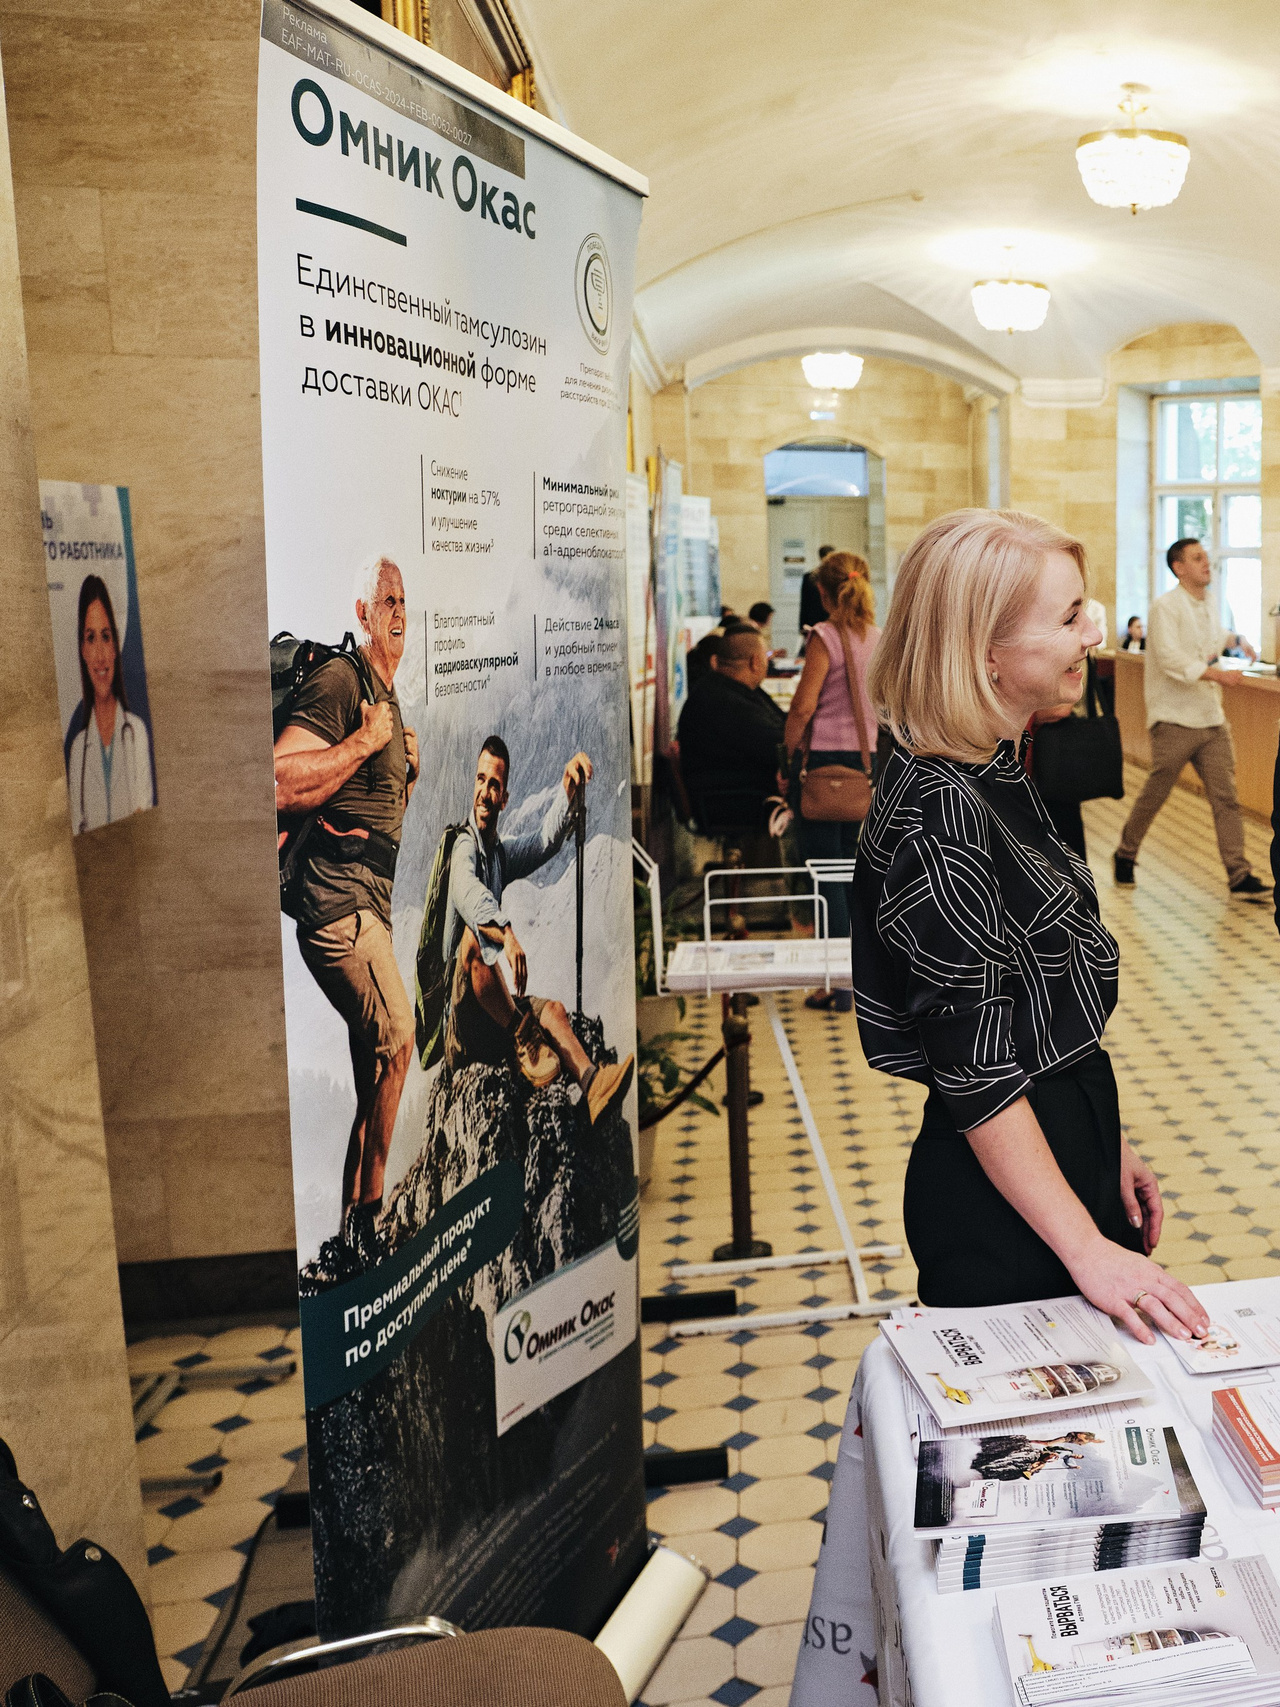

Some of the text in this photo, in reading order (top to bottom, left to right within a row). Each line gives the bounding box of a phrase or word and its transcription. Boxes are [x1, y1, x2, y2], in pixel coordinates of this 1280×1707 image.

[283, 6, 327, 45] Реклама
[291, 78, 536, 239] Омник Окас
[296, 252, 547, 356] Единственный тамсулозин
[300, 314, 536, 393] в инновационной форме
[301, 366, 412, 407] доставки
[430, 459, 469, 481] Снижение
[431, 486, 500, 507] ноктурии на 57%
[543, 477, 608, 496] Минимальный
[543, 499, 606, 517] ретроградной
[431, 516, 478, 531] и улучшение
[543, 524, 572, 538] среди
[60, 541, 123, 560] РАБОТНИКА
[431, 540, 462, 553] качества
[434, 612, 495, 629] Благоприятный
[545, 617, 619, 634] Действие 24 часа
[434, 637, 466, 654] профиль
[545, 645, 551, 655] и
[554, 640, 594, 658] удобный
[434, 652, 519, 676] кардиоваскулярной
[546, 666, 551, 676] в
[553, 661, 585, 676] любое
[343, 1197, 492, 1333] Премиальный продукт
[346, 1341, 371, 1367] по
[376, 1276, 438, 1352] доступной
[526, 1316, 576, 1360] Омник
[580, 1290, 615, 1326] Окас
[940, 1328, 982, 1365] ВЫРВАТЬСЯ
[1146, 1428, 1160, 1464] Омник Окас
[1050, 1585, 1078, 1637] ВЫРВАТЬСЯ
